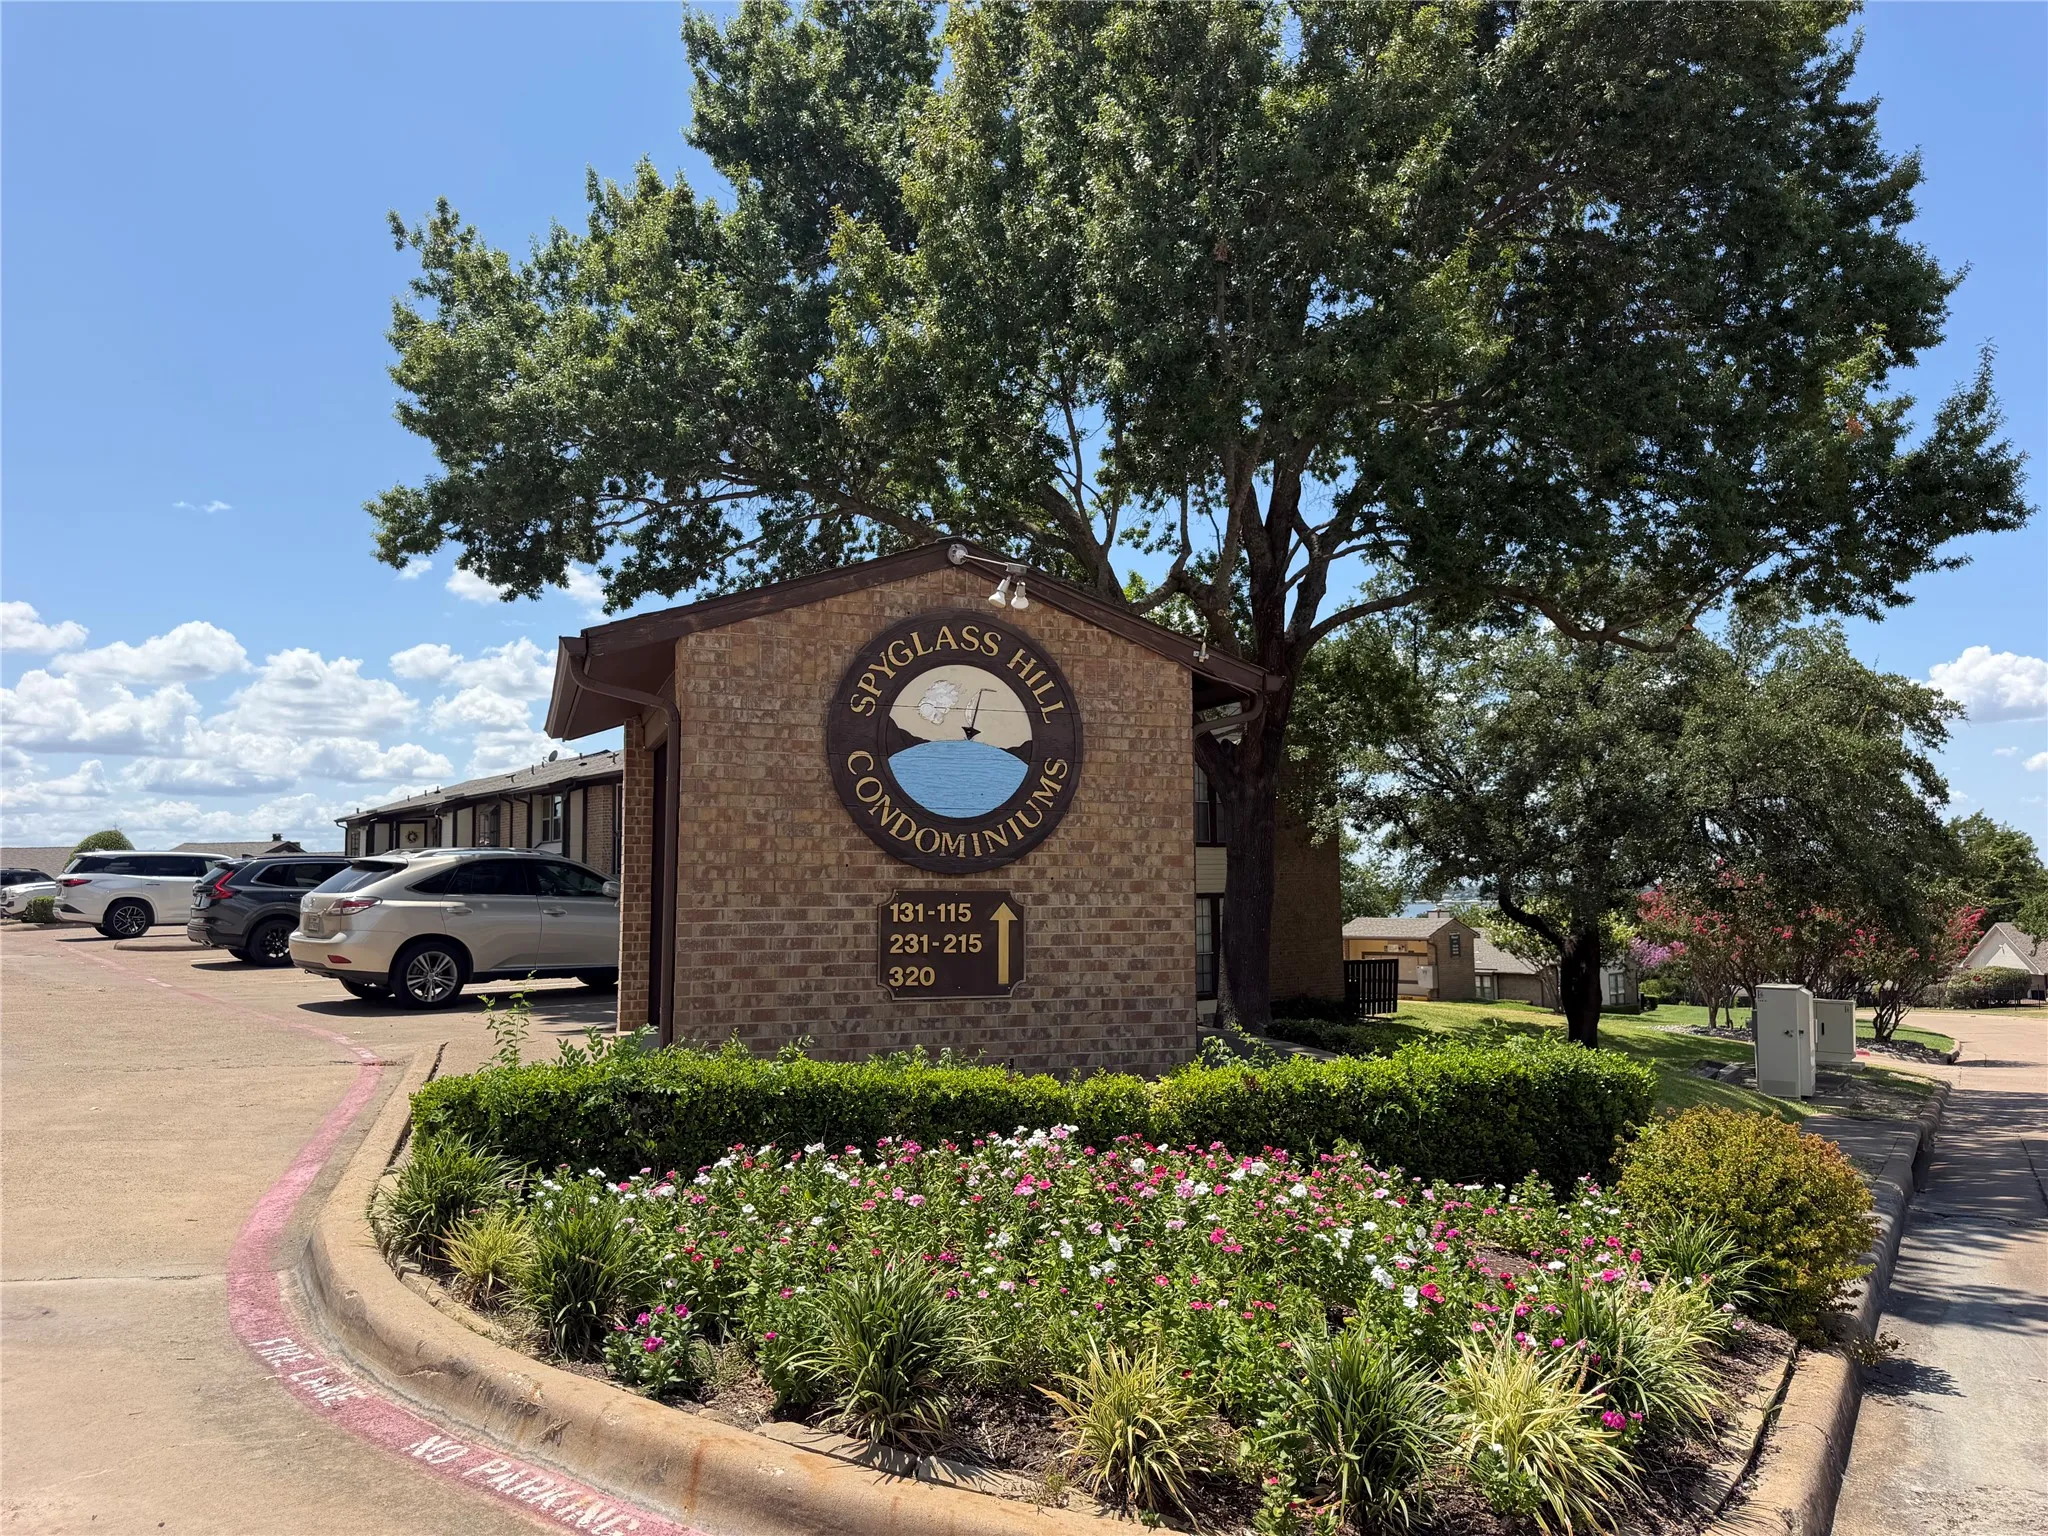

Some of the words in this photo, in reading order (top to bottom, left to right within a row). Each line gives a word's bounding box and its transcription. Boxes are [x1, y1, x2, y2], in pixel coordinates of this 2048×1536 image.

[851, 625, 1001, 717] SPYGLASS
[1007, 648, 1065, 724] HILL
[847, 750, 1068, 858] CONDOMINIUMS
[889, 902, 972, 923] 131-115
[888, 966, 936, 987] 320
[402, 1435, 470, 1465] NO
[461, 1457, 640, 1536] PARKING
